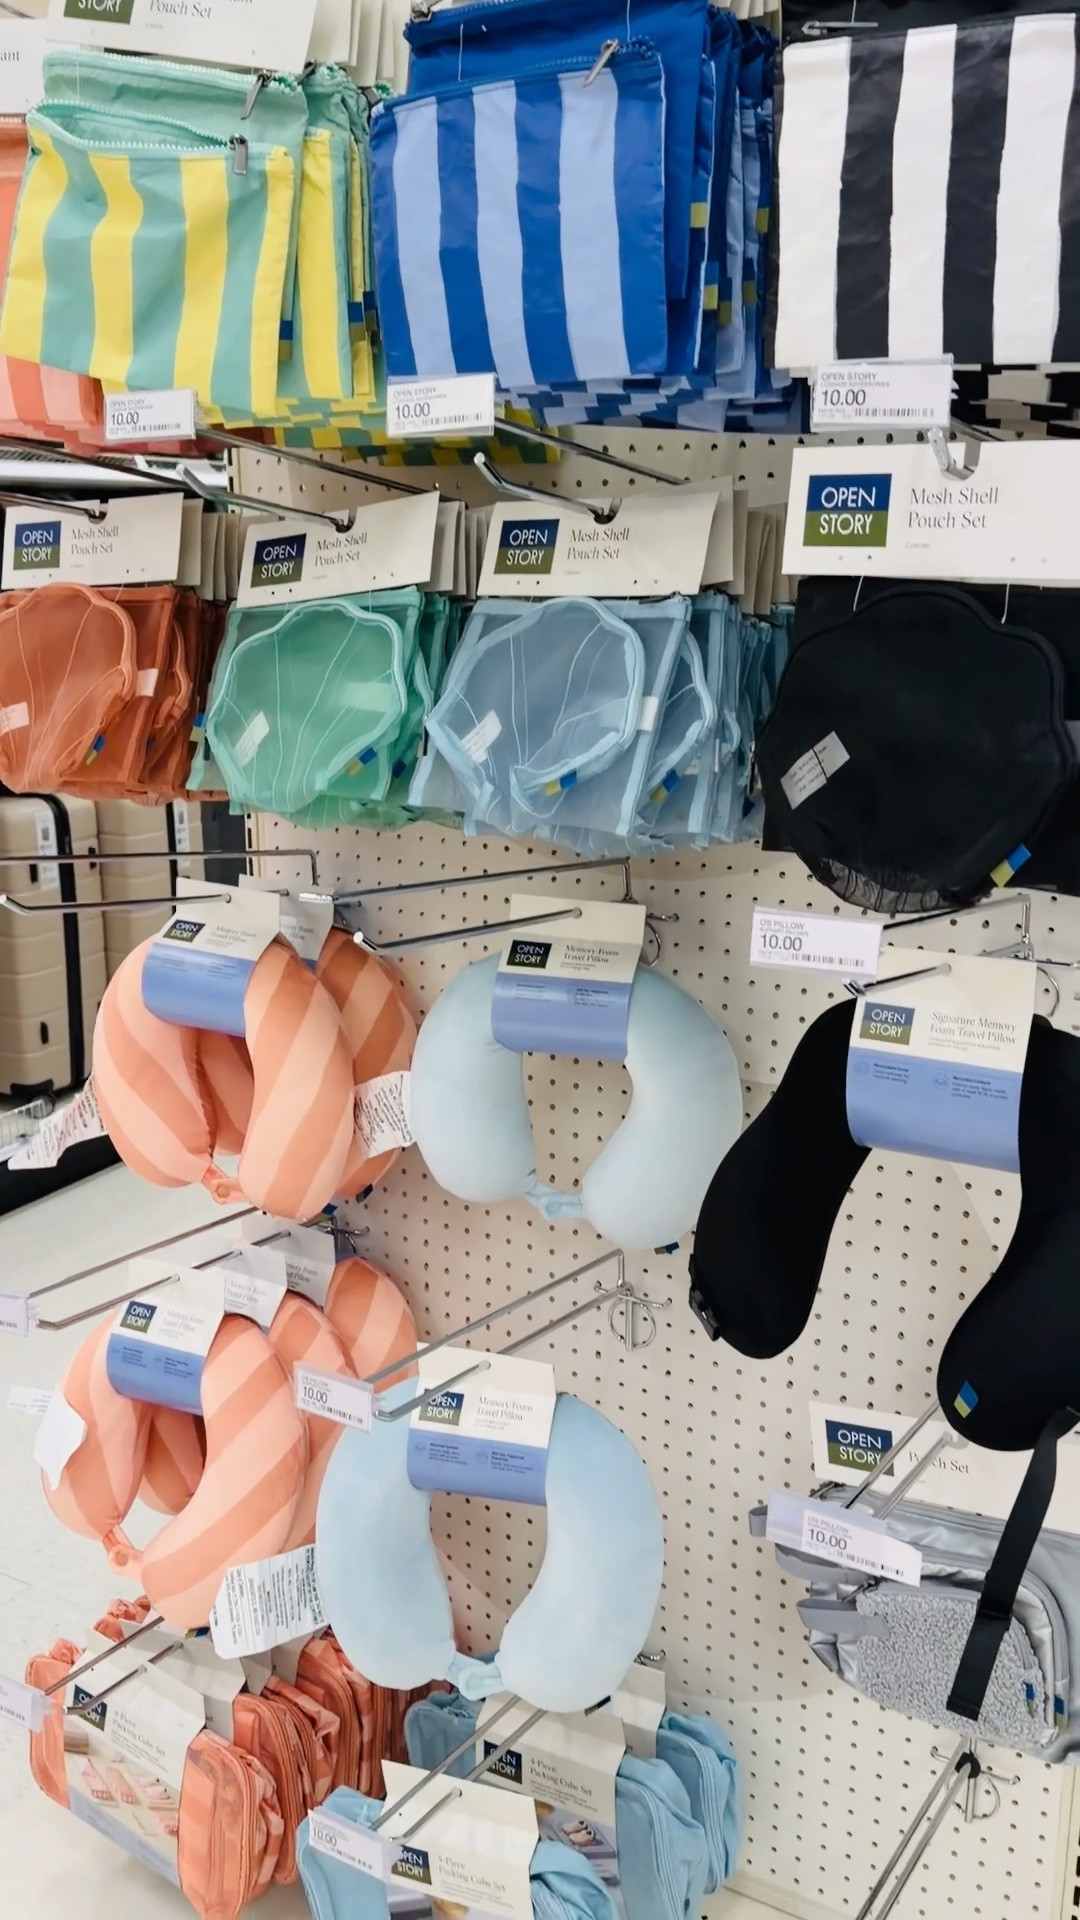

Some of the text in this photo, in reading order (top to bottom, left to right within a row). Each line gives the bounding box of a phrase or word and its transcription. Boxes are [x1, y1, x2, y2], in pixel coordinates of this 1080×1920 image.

[191, 3, 212, 19] Set
[847, 372, 877, 380] STORY
[821, 388, 866, 406] 10.00
[111, 411, 140, 426] 10.00
[395, 402, 431, 420] 10.00
[821, 486, 876, 508] OPEN
[910, 486, 999, 505] Mesh Shell
[819, 513, 873, 535] STORY
[908, 511, 987, 529] Pouch Set
[22, 529, 54, 546] OPEN
[97, 525, 119, 538] Shell
[344, 532, 368, 548] Shell
[509, 529, 548, 546] OPEN
[570, 527, 630, 542] Mesh Shell
[21, 546, 52, 562] STORY
[100, 541, 114, 554] Set
[262, 543, 297, 562] OPEN
[345, 549, 360, 562] Set
[567, 545, 620, 560] Pouch Set
[506, 548, 544, 565] STORY
[260, 561, 295, 579] STORY
[175, 921, 199, 932] OPEN
[773, 920, 805, 931] PILLOW
[170, 930, 193, 939] STORY
[760, 933, 803, 951] 10.00
[517, 944, 544, 955] OPEN
[514, 953, 542, 964] STORY
[871, 1008, 906, 1025] OPEN
[931, 1011, 1017, 1033] Signature Memory
[869, 1021, 903, 1038] STORY
[930, 1023, 956, 1036] Foam
[957, 1026, 985, 1040] Travel
[986, 1031, 1018, 1045] Pillow
[130, 1305, 151, 1318] OPEN
[126, 1315, 146, 1328] STORY
[303, 1386, 328, 1404] 10.00
[427, 1406, 455, 1419] STORY
[837, 1429, 882, 1449] OPEN
[839, 1446, 882, 1465] STORY
[950, 1460, 969, 1474] Set
[809, 1528, 847, 1550] 10.00
[313, 1827, 337, 1847] 10.00
